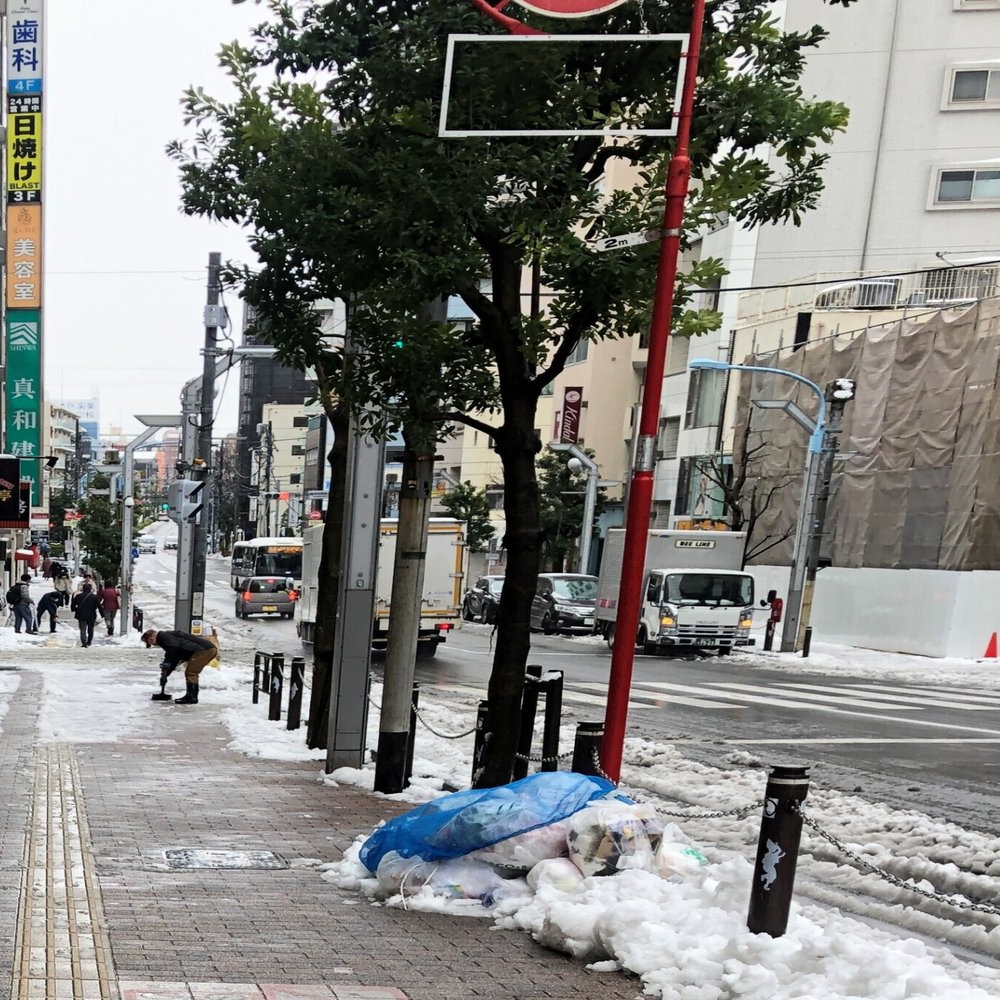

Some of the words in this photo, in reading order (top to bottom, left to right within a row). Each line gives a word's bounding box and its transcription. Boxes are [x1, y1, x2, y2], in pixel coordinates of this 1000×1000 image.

[12, 19, 38, 72] 歯科
[15, 81, 34, 91] 4F
[13, 115, 37, 181] 日焼け
[9, 182, 40, 190] BLAST
[13, 190, 36, 201] 3F
[14, 238, 36, 300] 美容室
[563, 405, 578, 443] Kindal
